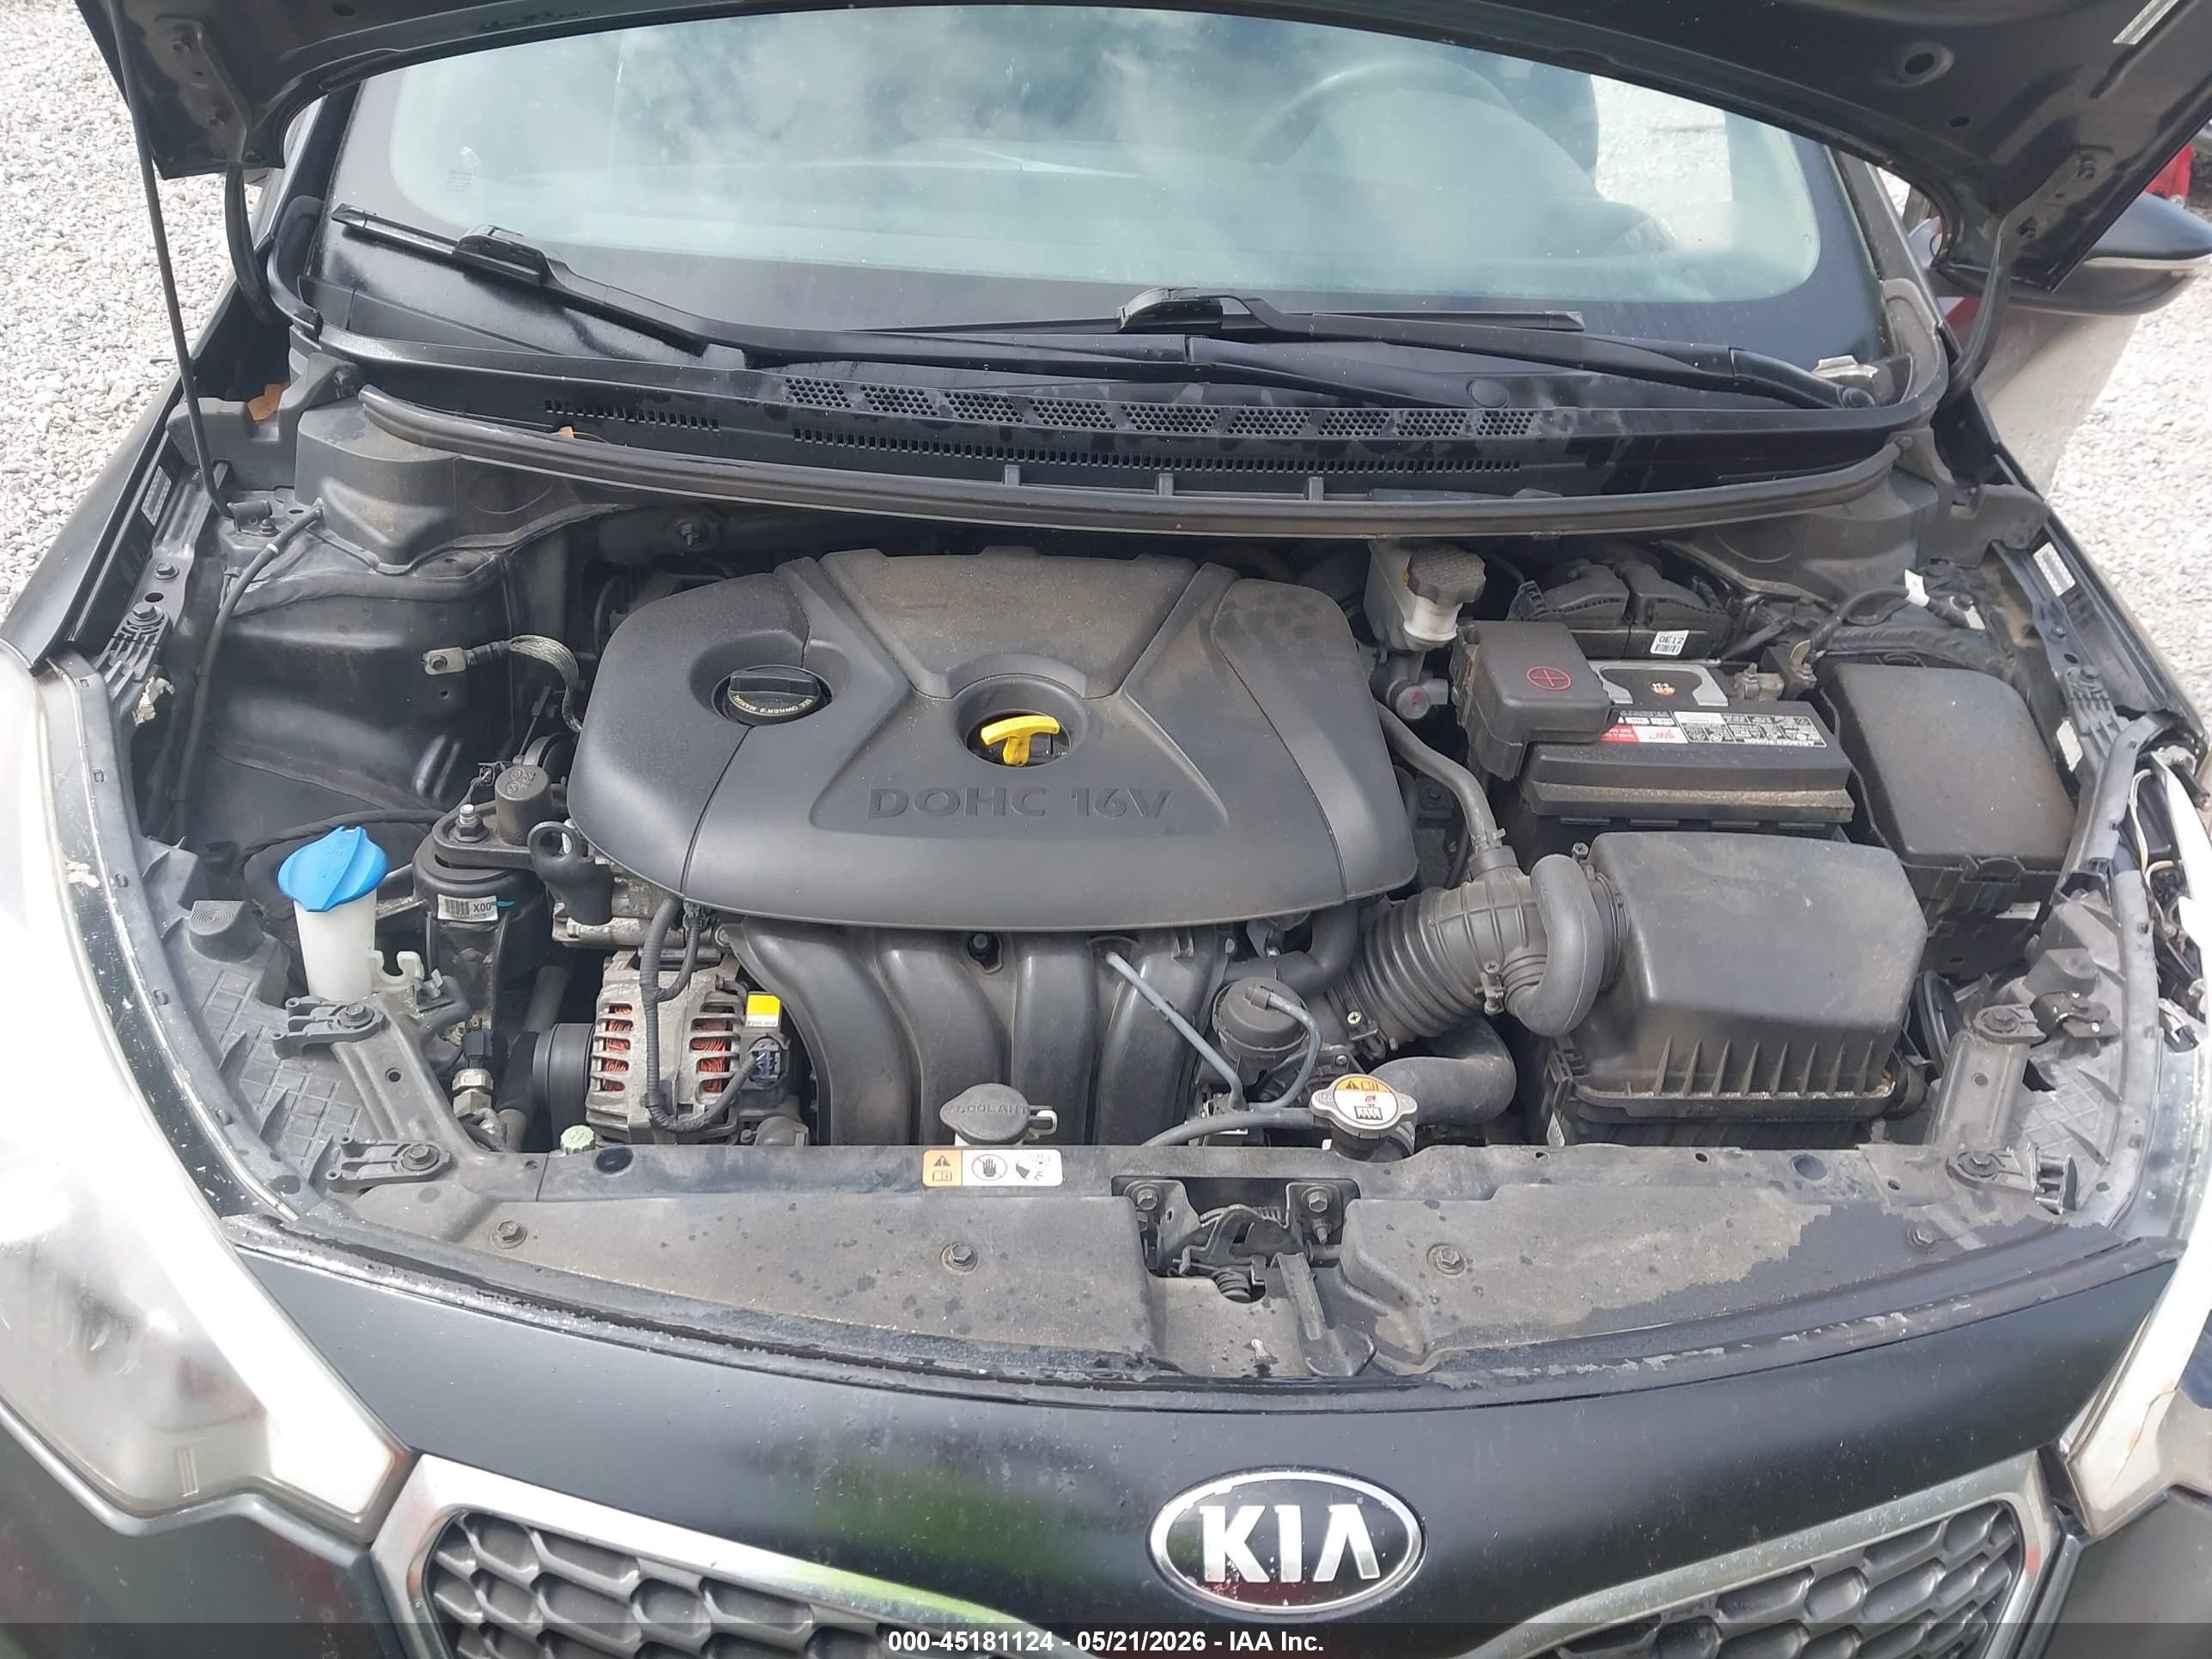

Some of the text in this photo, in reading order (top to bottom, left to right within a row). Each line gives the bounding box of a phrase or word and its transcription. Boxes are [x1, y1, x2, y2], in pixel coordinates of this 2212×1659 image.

[732, 695, 757, 711] MANUAL
[759, 705, 799, 714] OWNER'S
[867, 787, 1171, 818] DOHC 16V
[957, 1103, 1028, 1114] COOLANT
[1200, 1504, 1381, 1583] KIA
